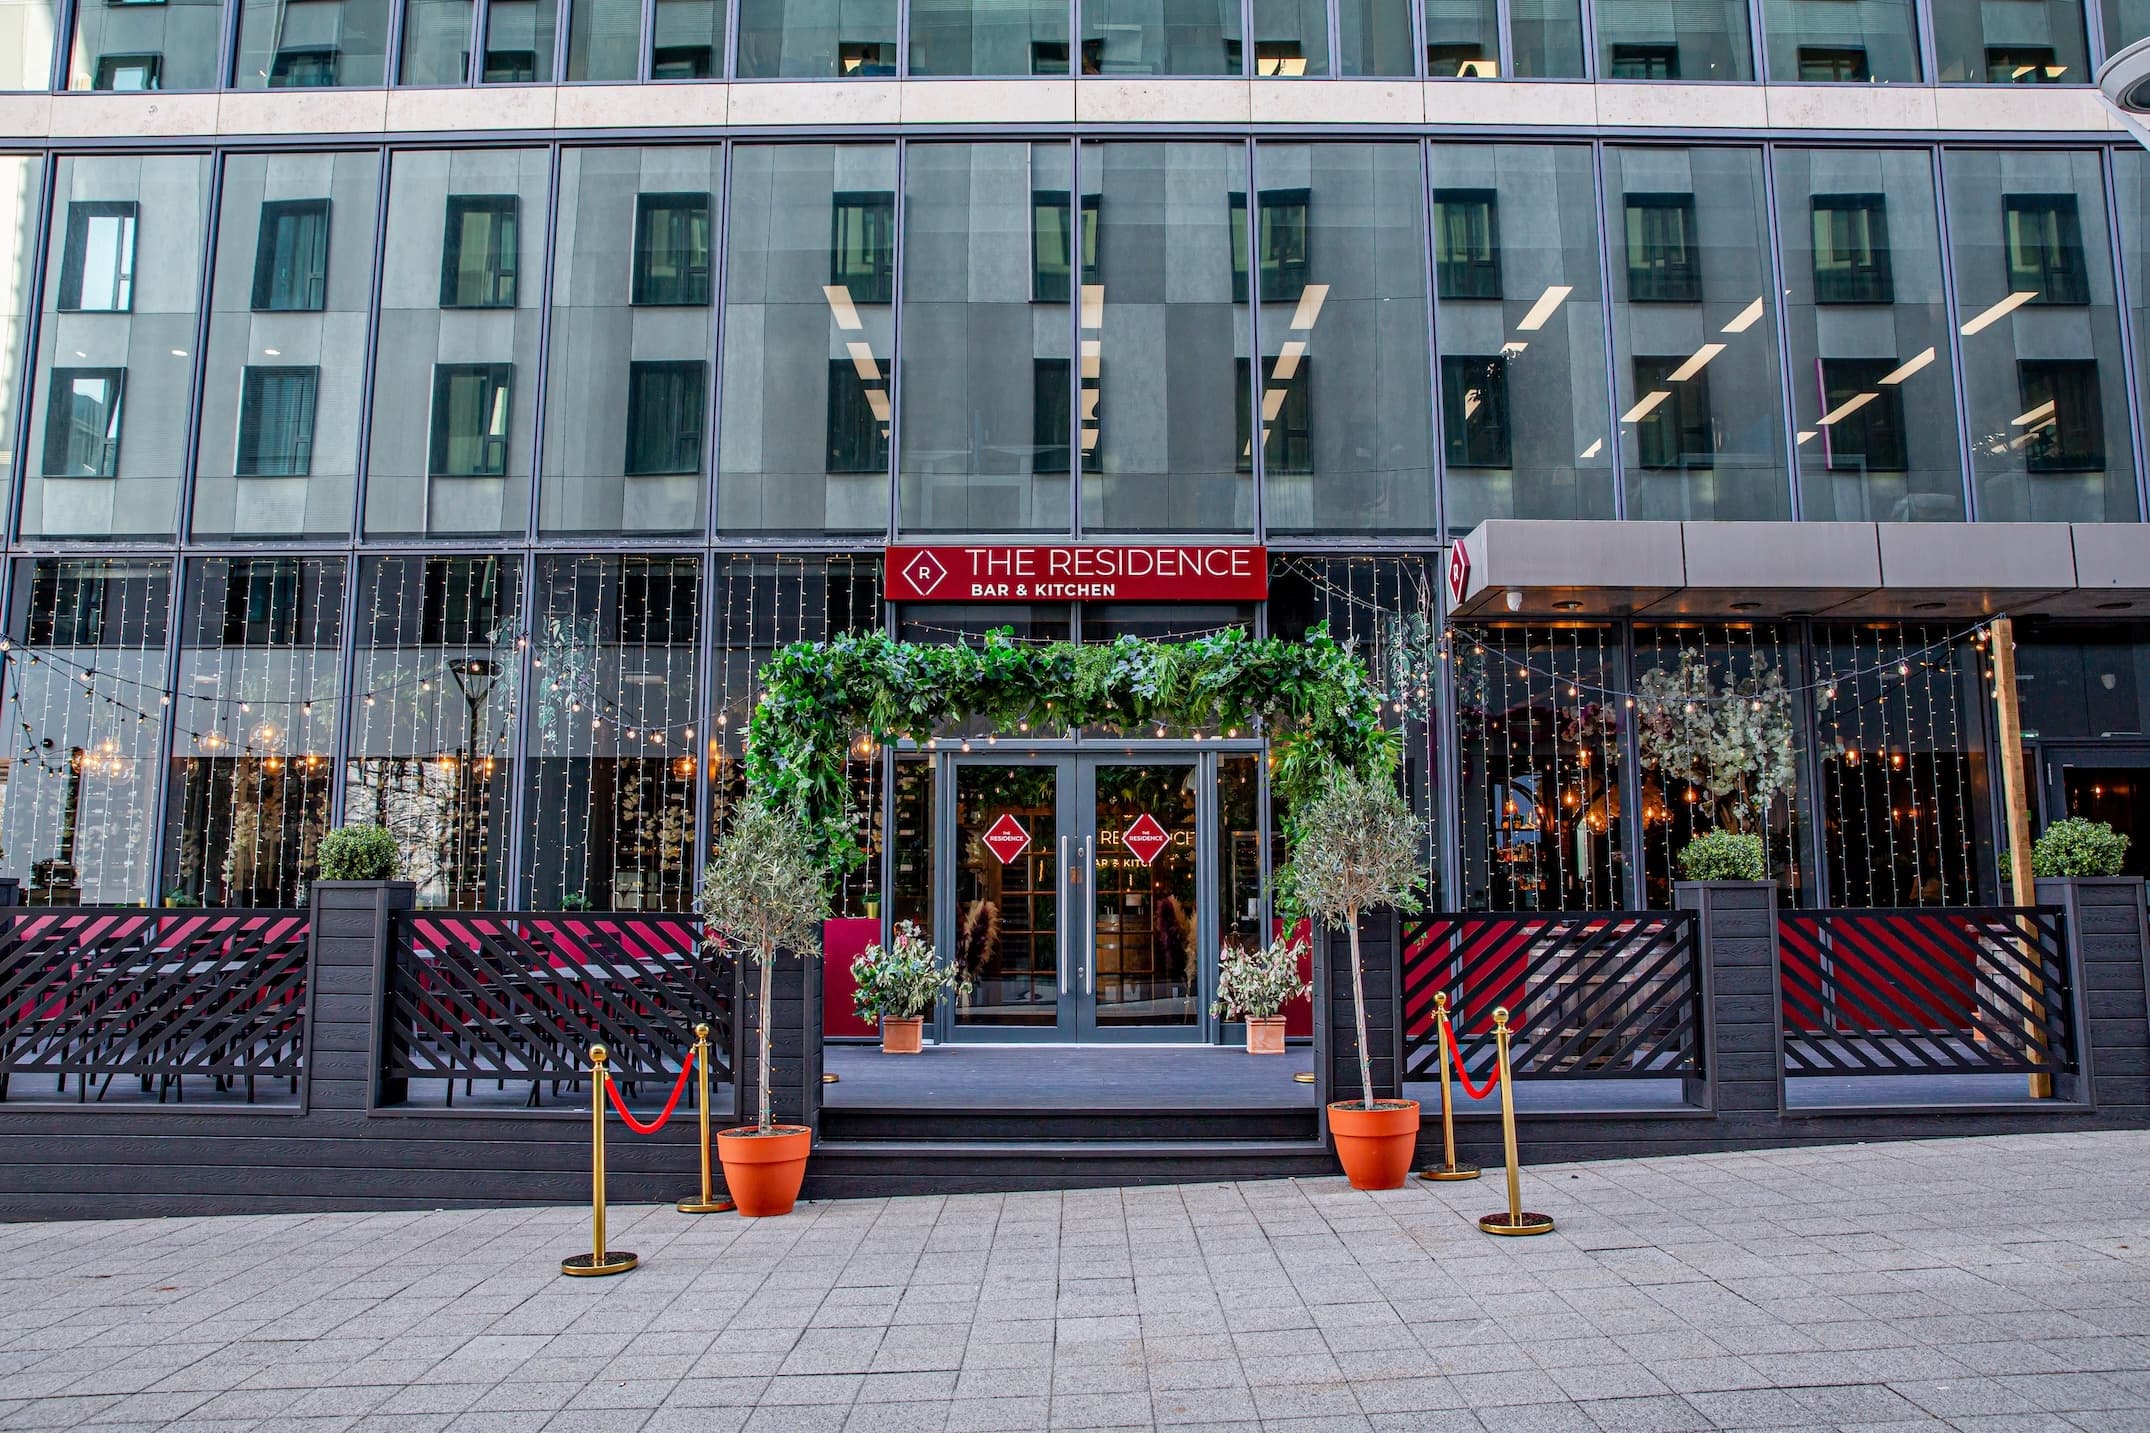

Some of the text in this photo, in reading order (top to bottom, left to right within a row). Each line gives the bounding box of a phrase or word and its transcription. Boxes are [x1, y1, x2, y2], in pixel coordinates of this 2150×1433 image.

[964, 549, 1251, 576] THE RESIDENCE
[919, 566, 930, 579] R
[1453, 563, 1459, 582] R
[971, 583, 1115, 597] BAR & KITCHEN
